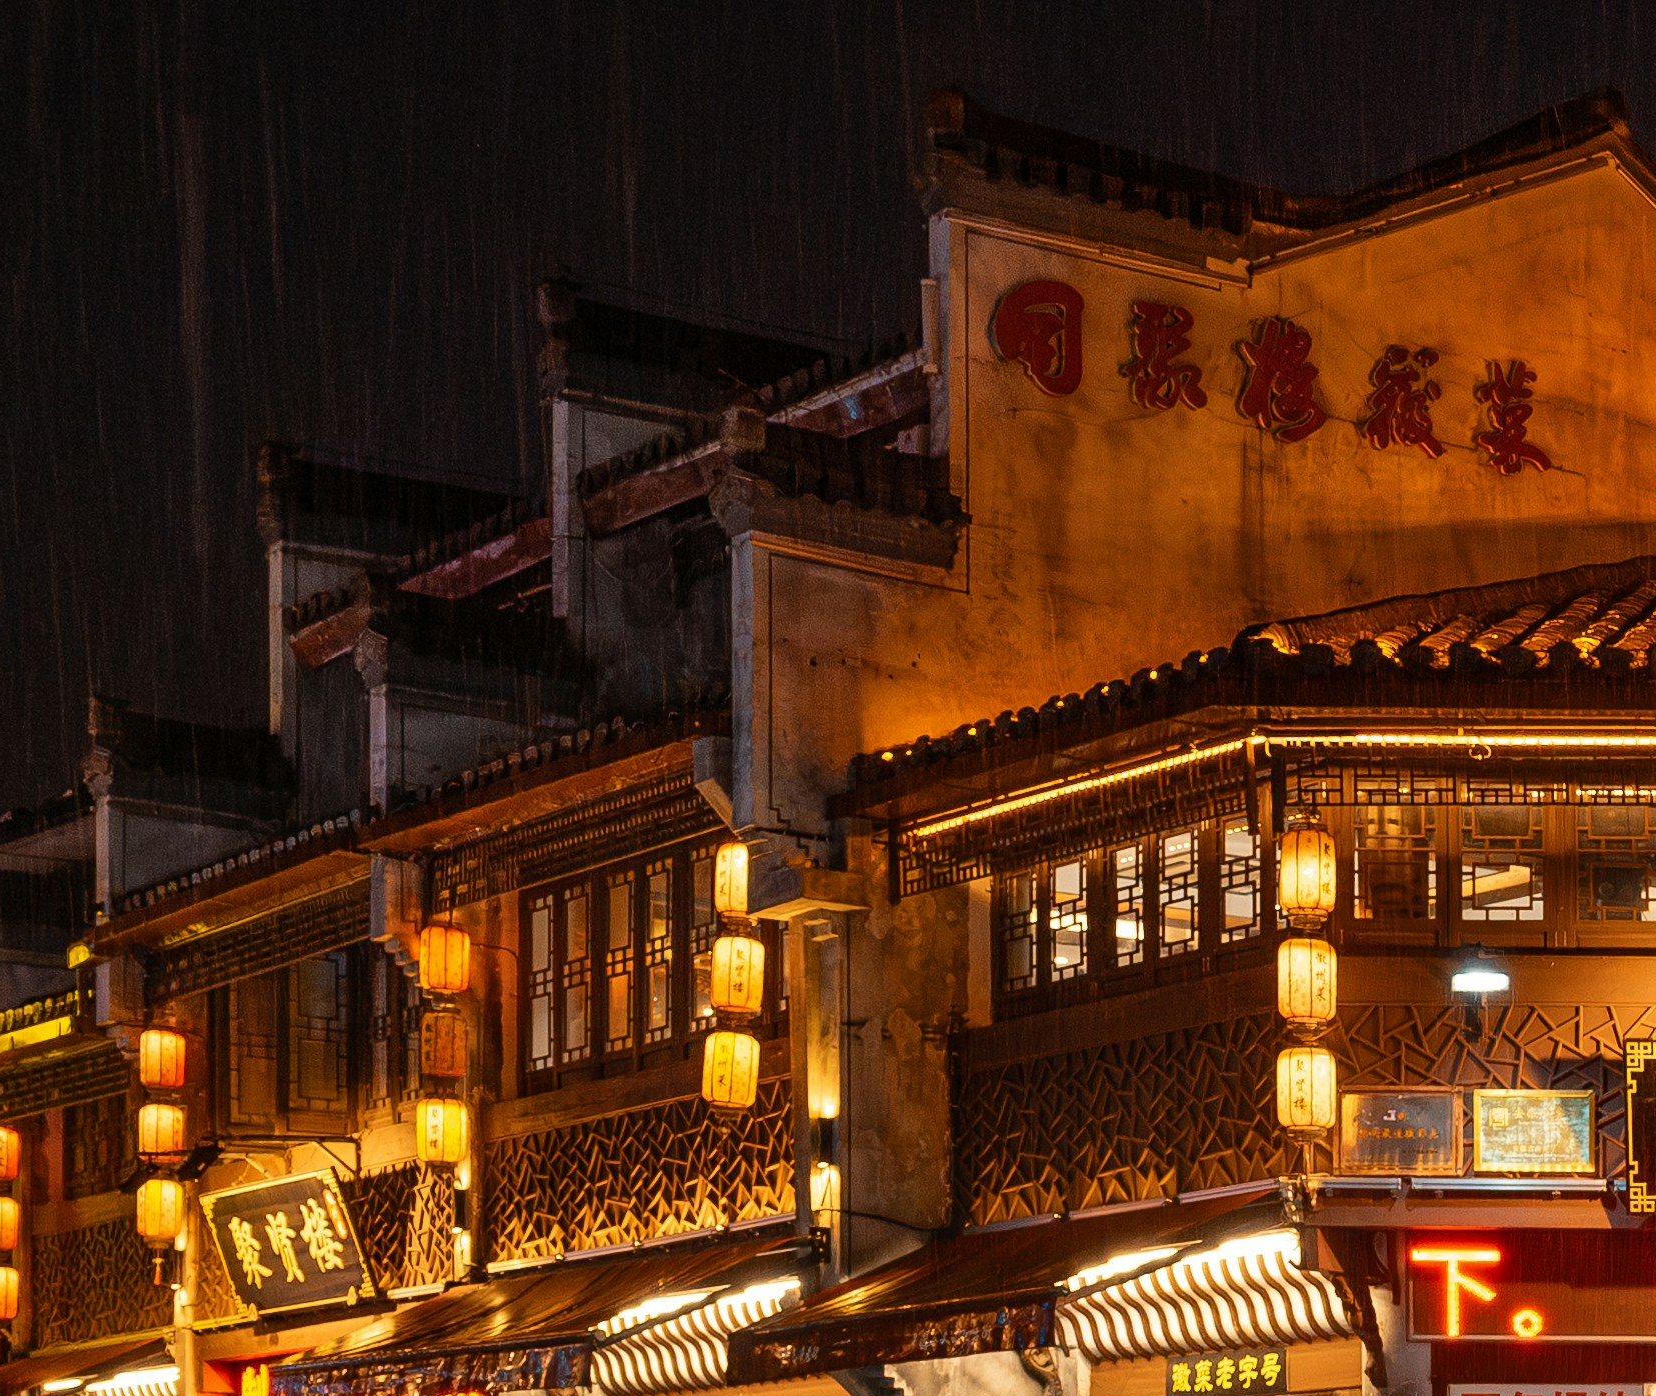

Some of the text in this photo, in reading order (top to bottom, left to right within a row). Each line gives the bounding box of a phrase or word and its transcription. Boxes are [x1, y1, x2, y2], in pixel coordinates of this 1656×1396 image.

[227, 1197, 345, 1291] 聚贤楼
[1171, 1352, 1282, 1393] 徽菜老字号
